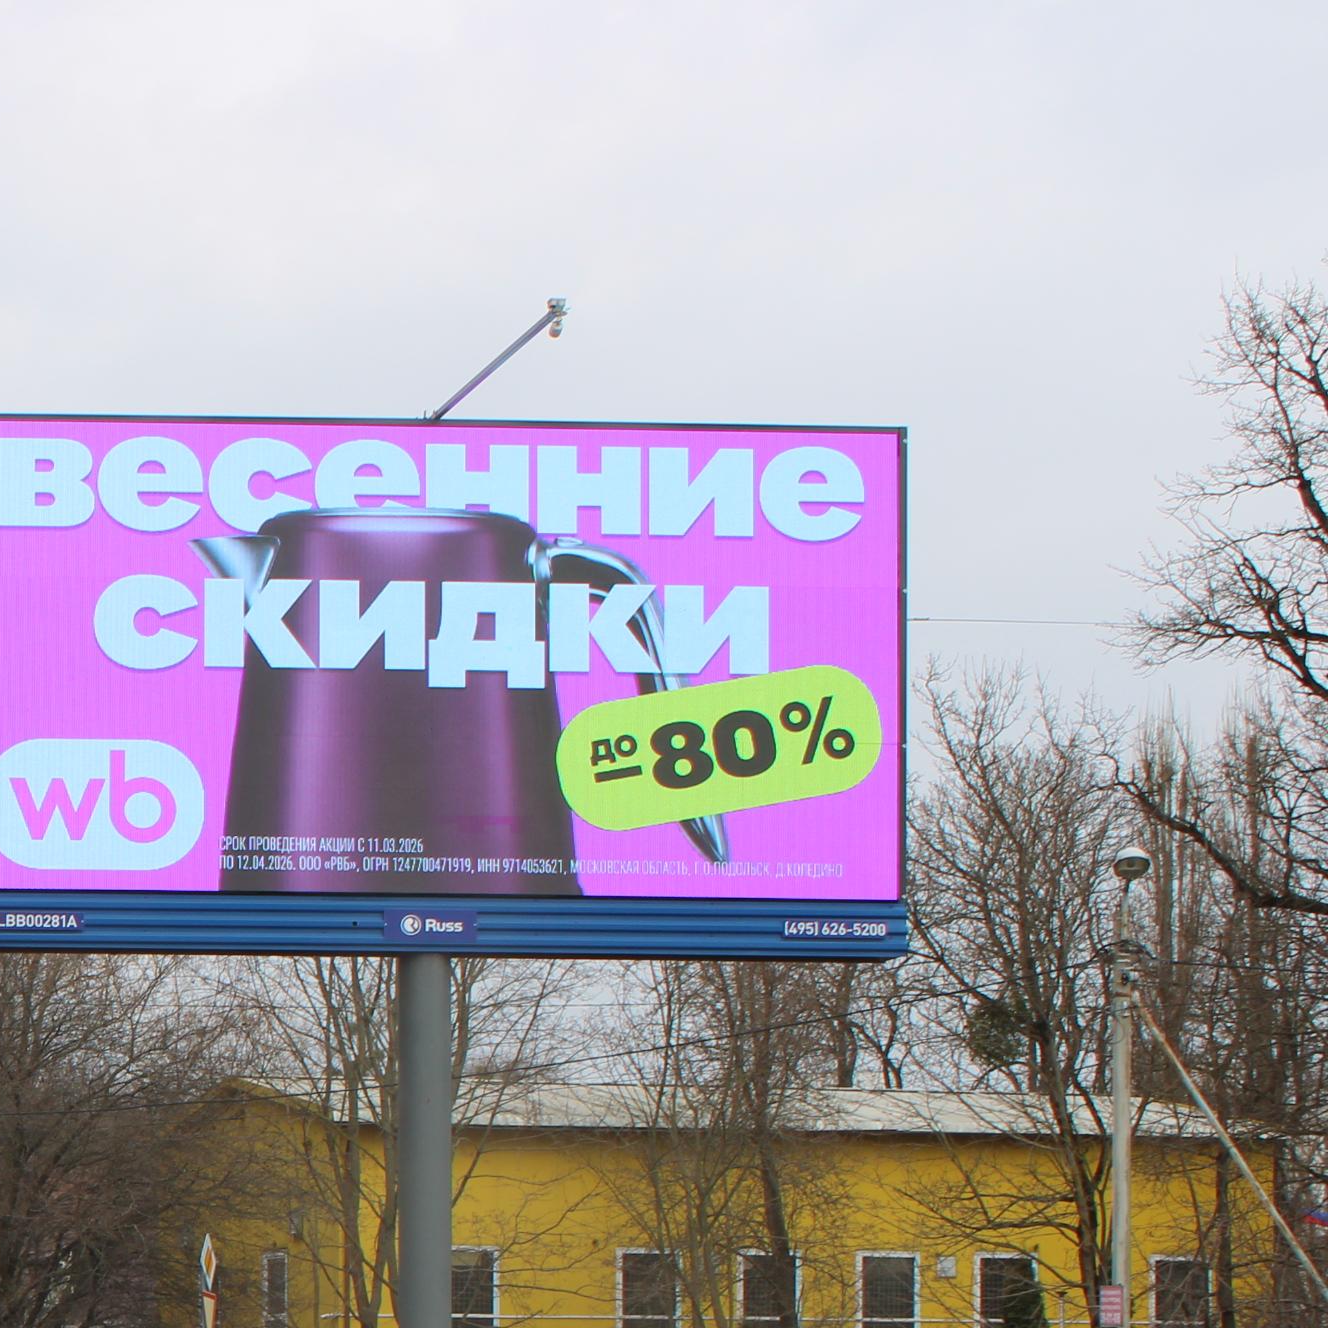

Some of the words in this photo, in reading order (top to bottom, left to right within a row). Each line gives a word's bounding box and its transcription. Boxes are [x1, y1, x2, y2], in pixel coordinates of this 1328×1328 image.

[94, 574, 769, 689] скидки
[591, 734, 638, 767] до
[650, 695, 855, 790] 80%
[8, 750, 177, 844] wb
[219, 835, 246, 851] СРОК
[249, 836, 316, 853] ПРОВЕДЕНИЯ
[319, 837, 355, 853] АКЦИИ
[357, 838, 365, 852] С
[367, 838, 424, 853] 11.03.2026
[219, 855, 234, 870] ПО
[238, 855, 296, 871] 12.04.2026.
[299, 856, 322, 871] ООО
[324, 856, 360, 873] «РВБ»,
[362, 856, 389, 872] ОГРН
[392, 857, 475, 874] 1247700471919,
[477, 858, 500, 873] ИНН
[503, 859, 567, 875] 9714053621,
[570, 859, 639, 874] МОСКОВСКАЯ
[425, 918, 463, 932] Russ
[784, 921, 818, 936] (495)
[821, 922, 886, 936] 626-5200
